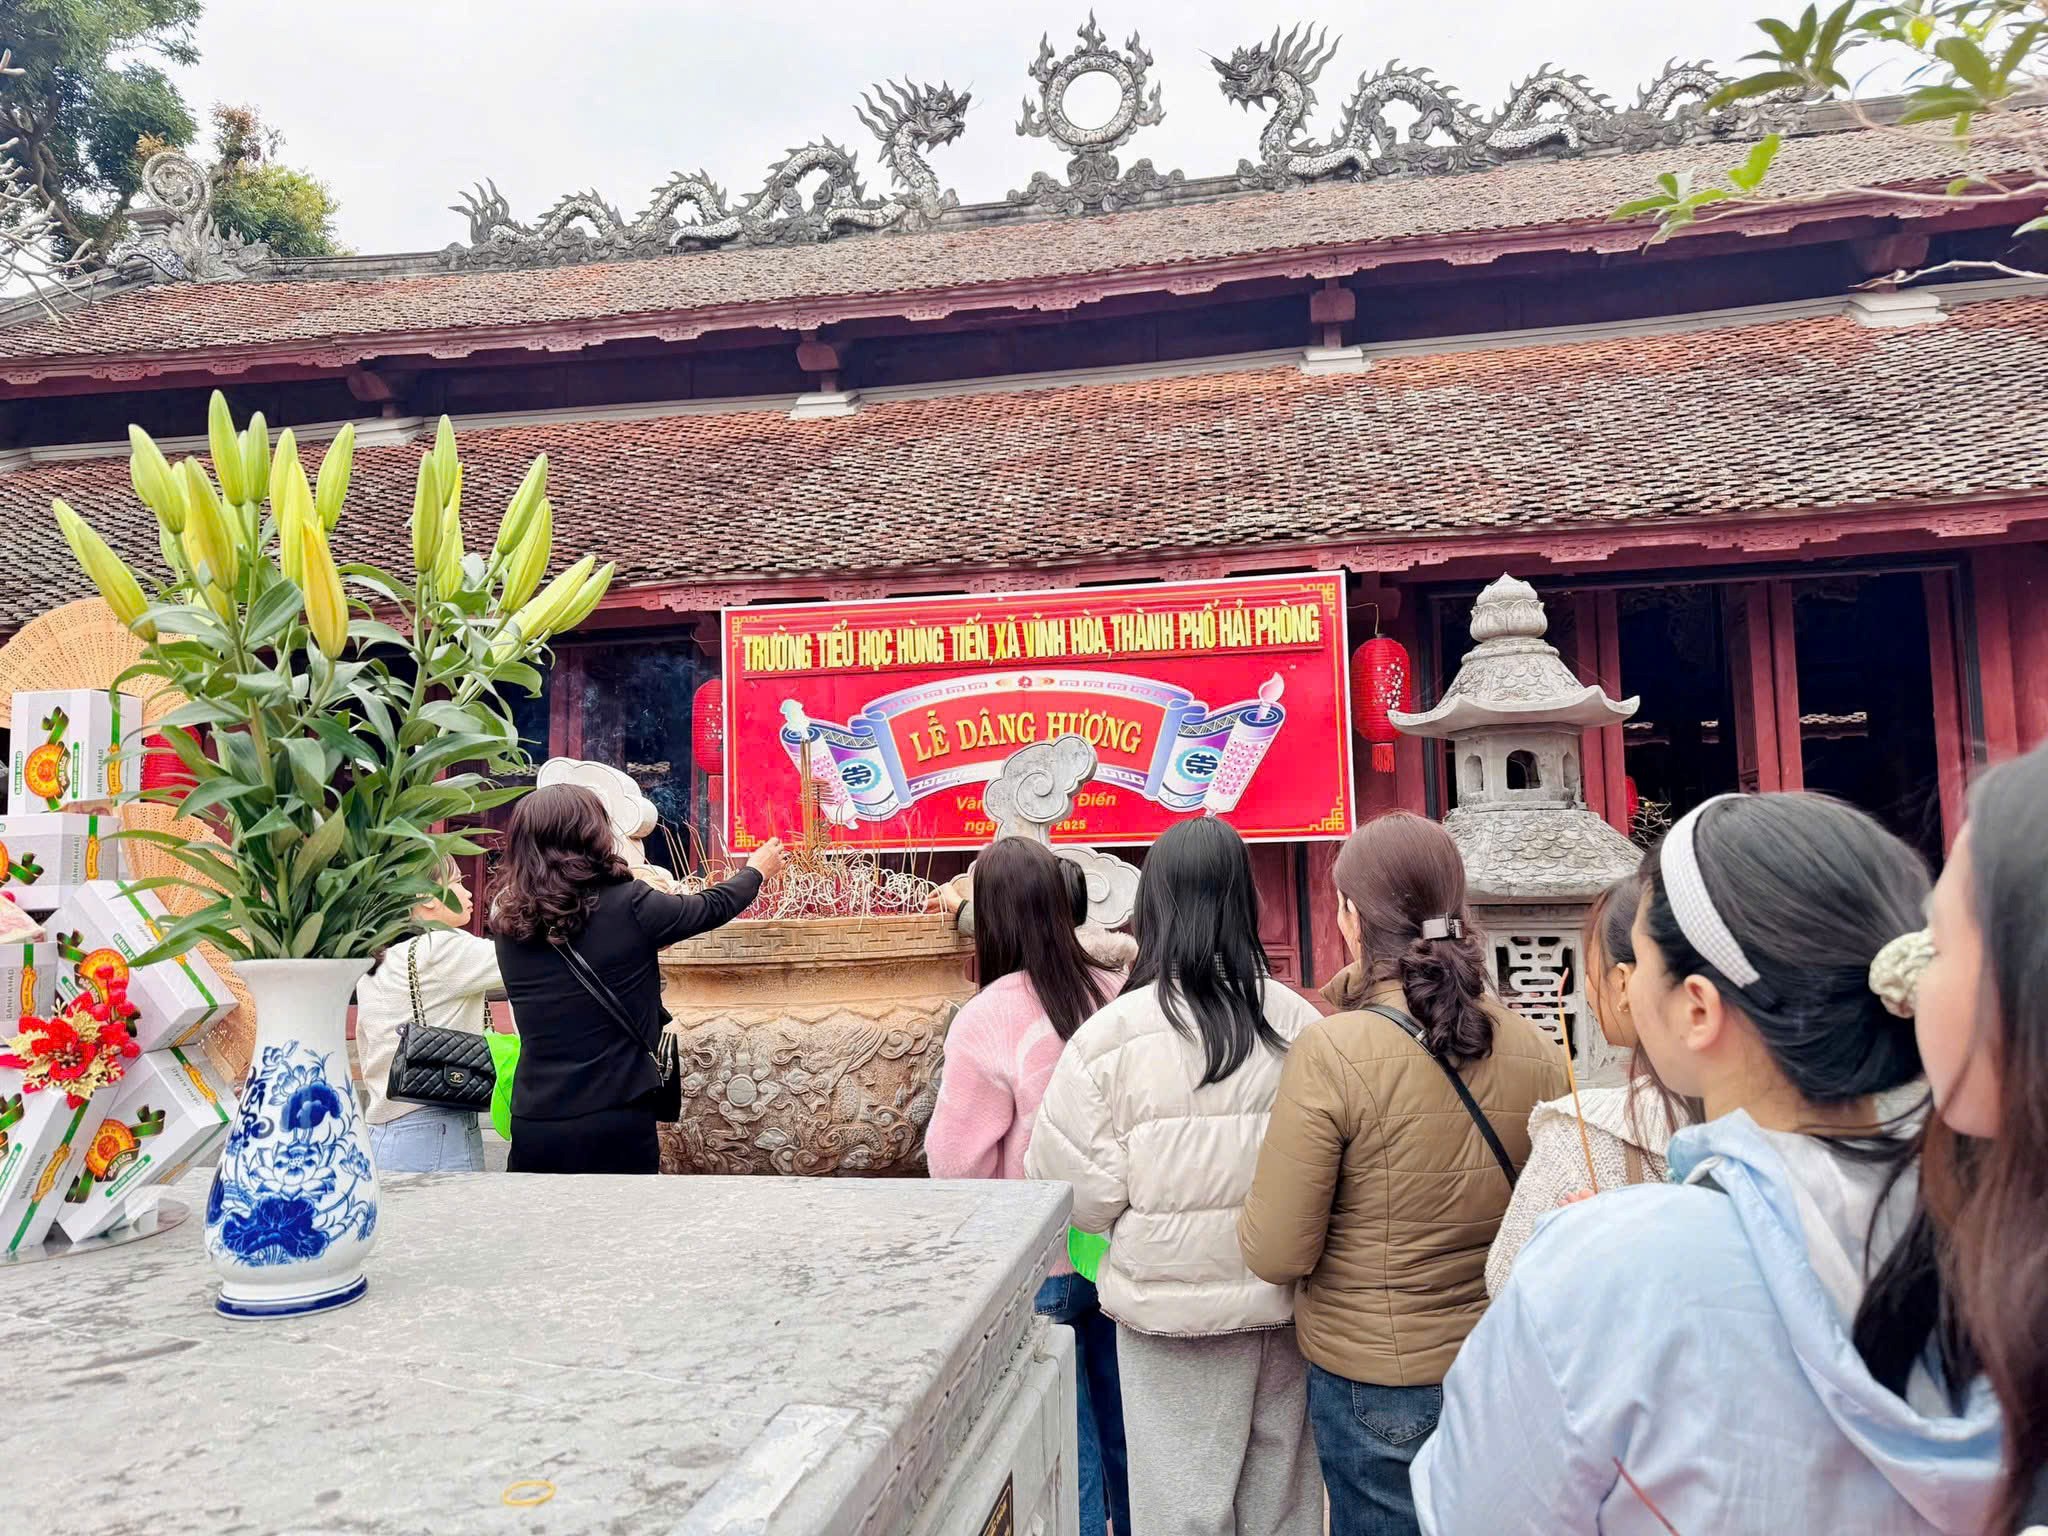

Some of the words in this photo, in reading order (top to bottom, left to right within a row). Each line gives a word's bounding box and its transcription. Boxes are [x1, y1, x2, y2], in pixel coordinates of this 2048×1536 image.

[742, 624, 813, 672] TRƯỜNG
[816, 618, 855, 669] TIỂU
[858, 628, 893, 671] HỌC
[897, 619, 945, 665] HÙNG
[1023, 611, 1066, 659] VĨNH
[1179, 598, 1219, 649] PHỐ
[1219, 598, 1251, 648] HẢI
[1255, 599, 1321, 646] PHÒNG
[909, 708, 951, 763] LỄ
[955, 706, 1037, 751] DÂNG
[1046, 707, 1144, 755] HƯƠNG
[1055, 820, 1087, 832] 2025
